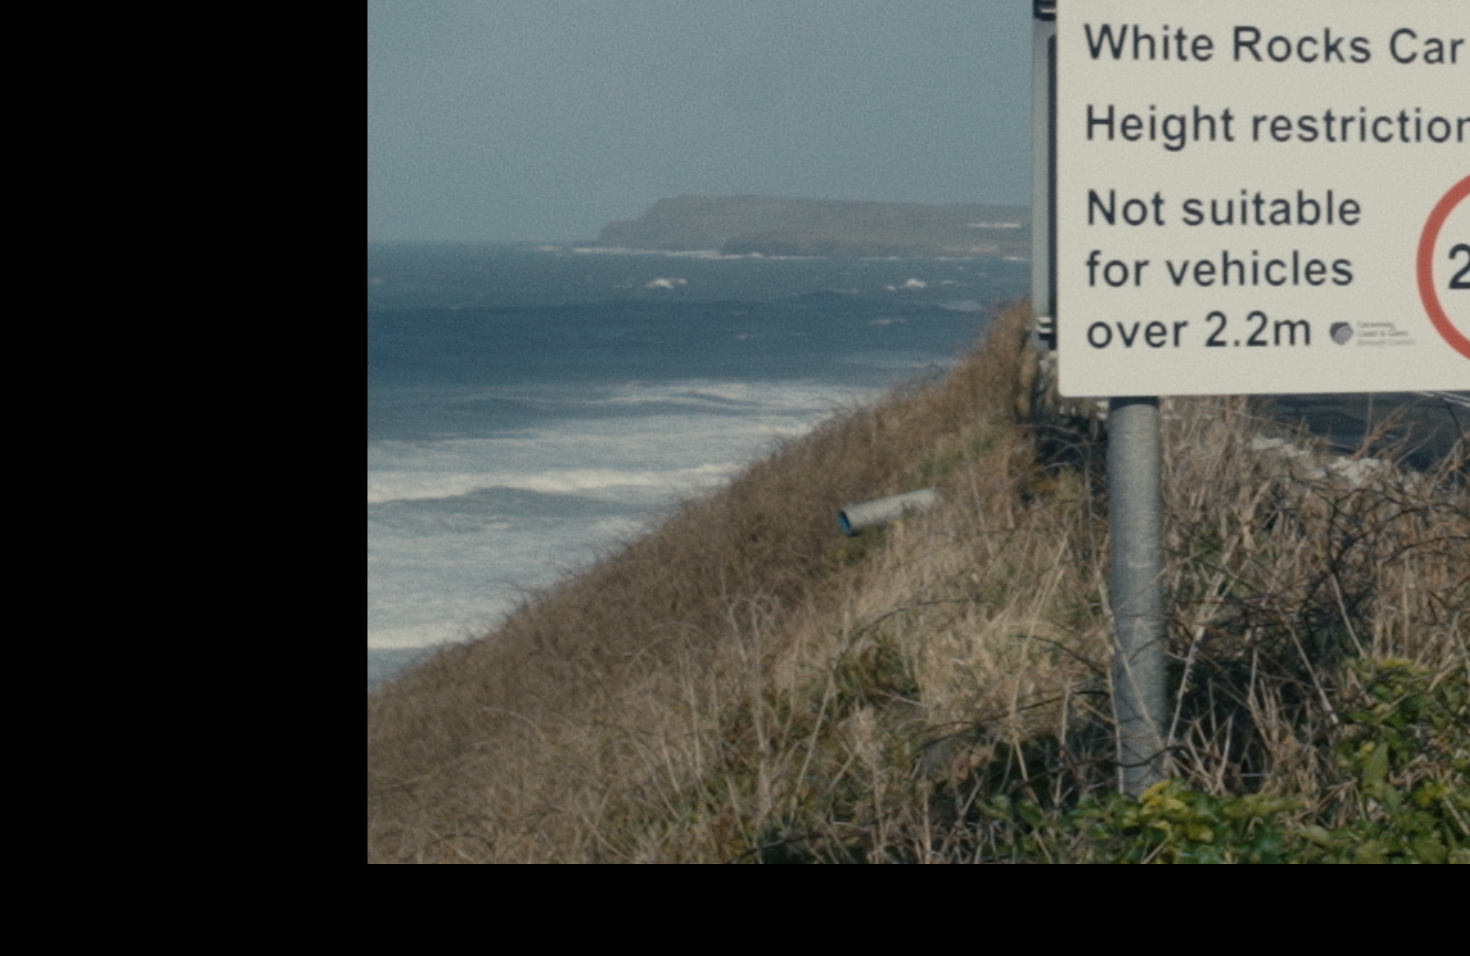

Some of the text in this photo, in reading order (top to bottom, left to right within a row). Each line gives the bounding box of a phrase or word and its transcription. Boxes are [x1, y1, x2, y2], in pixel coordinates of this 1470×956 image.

[1083, 23, 1214, 62] White
[1233, 25, 1371, 64] Rocks
[1389, 27, 1465, 65] Car
[1086, 104, 1235, 152] Height
[1088, 189, 1361, 227] Not suitable
[1086, 249, 1353, 288] for vehicles
[1086, 310, 1311, 349] over 2.2m
